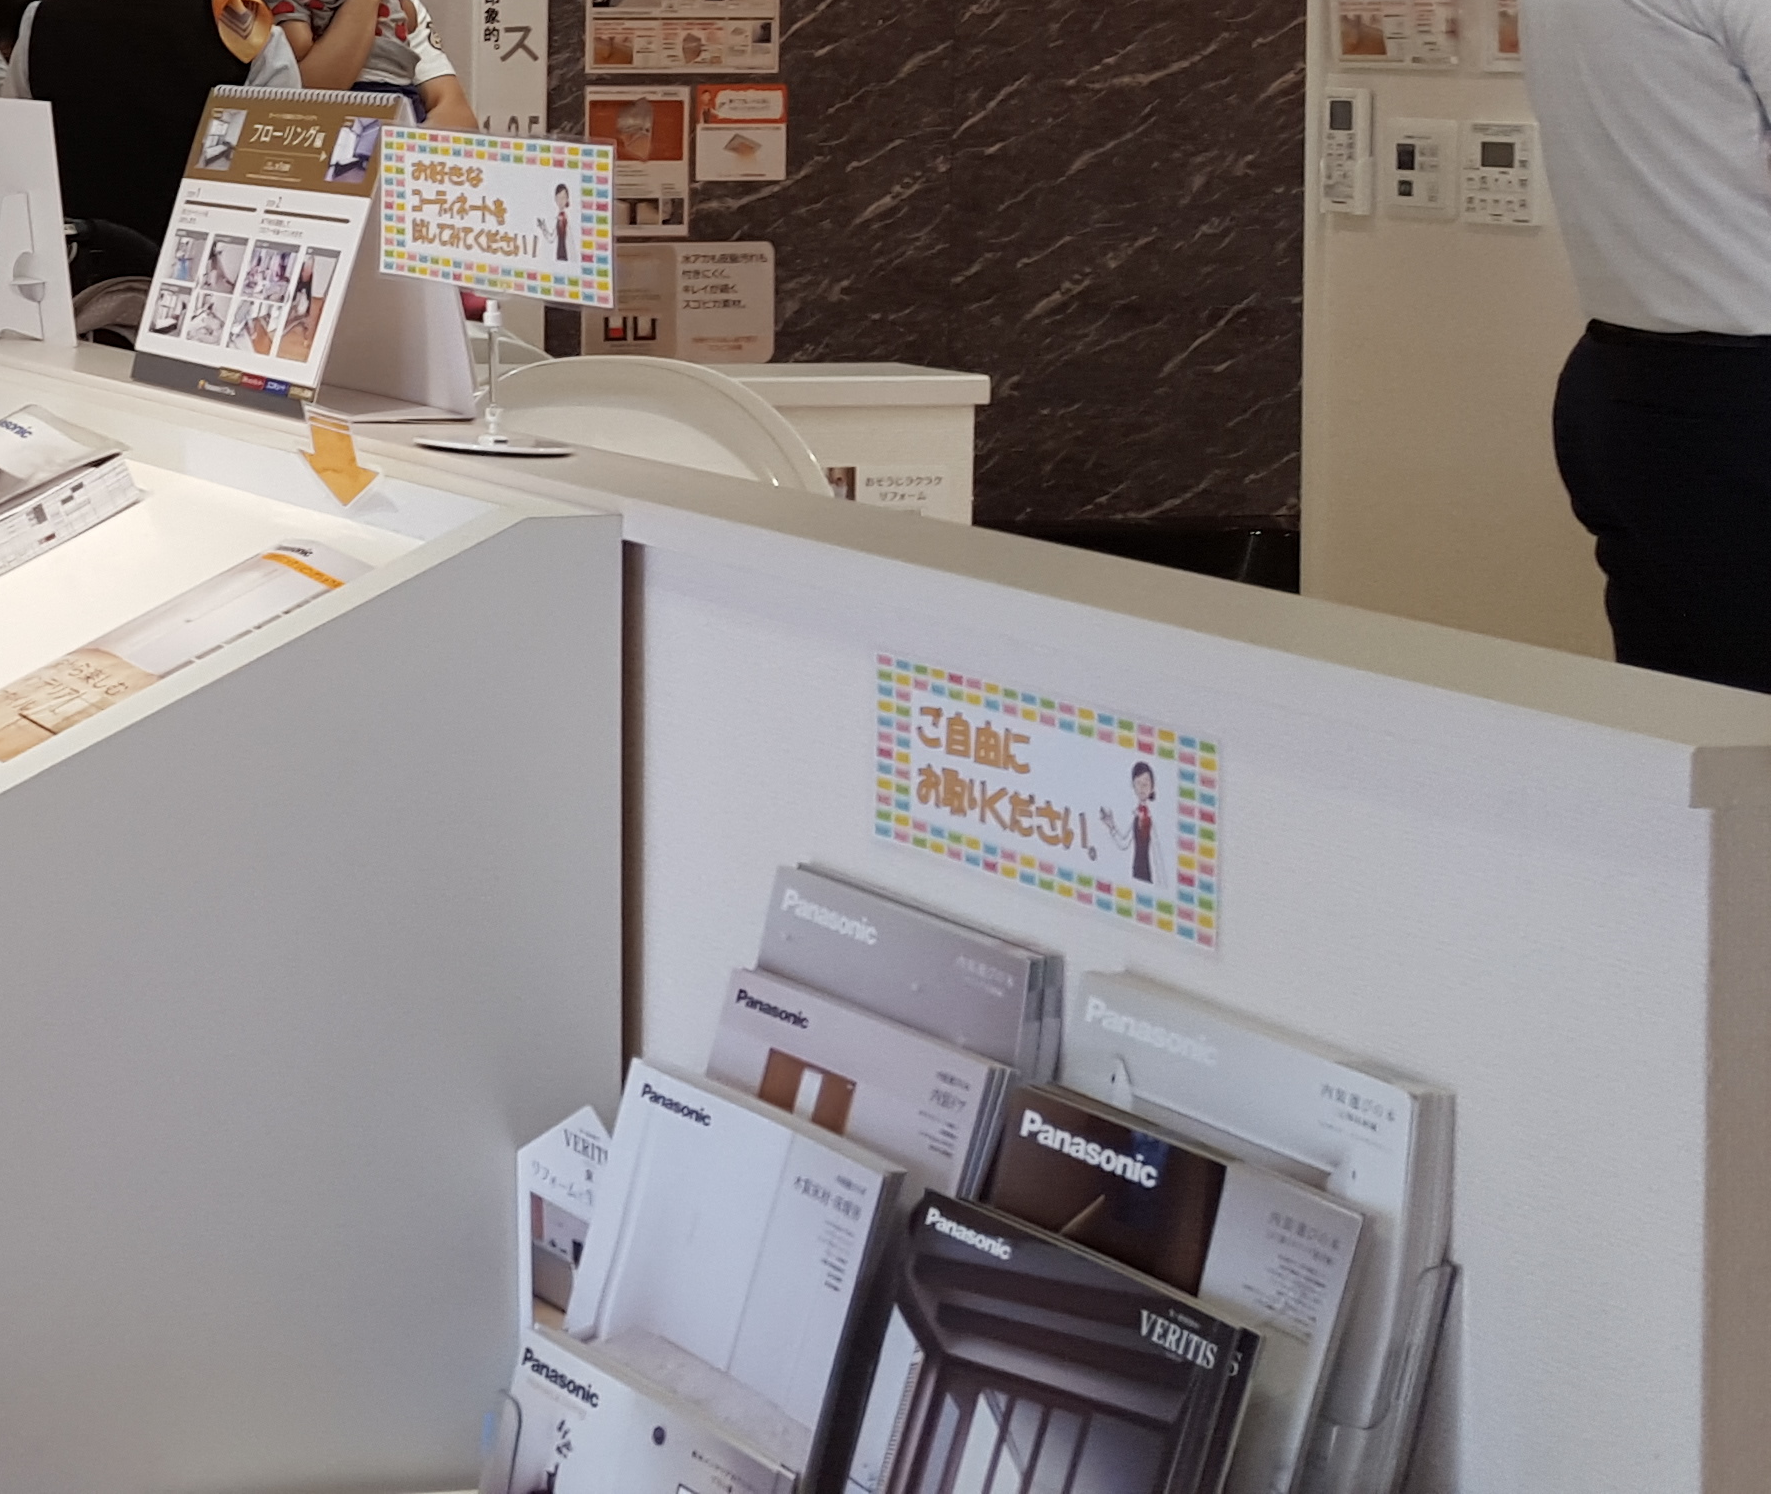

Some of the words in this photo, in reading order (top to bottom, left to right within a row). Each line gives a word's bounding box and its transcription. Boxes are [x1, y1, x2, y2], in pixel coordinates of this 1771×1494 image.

[411, 160, 484, 188] お好きな
[411, 189, 508, 226] コーディネートを
[917, 706, 1032, 775] ご自由に
[917, 763, 1097, 862] お取りください。
[780, 889, 879, 945] Panasonic
[735, 988, 809, 1030] Panasonic
[1084, 995, 1218, 1068] Panasonic
[641, 1082, 712, 1127] Panasonic
[563, 1128, 608, 1164] VERIT
[1019, 1108, 1159, 1189] Panasonic
[924, 1206, 1014, 1260] Panasonic
[1138, 1308, 1219, 1370] VERITIS
[521, 1346, 600, 1409] Panasonic
